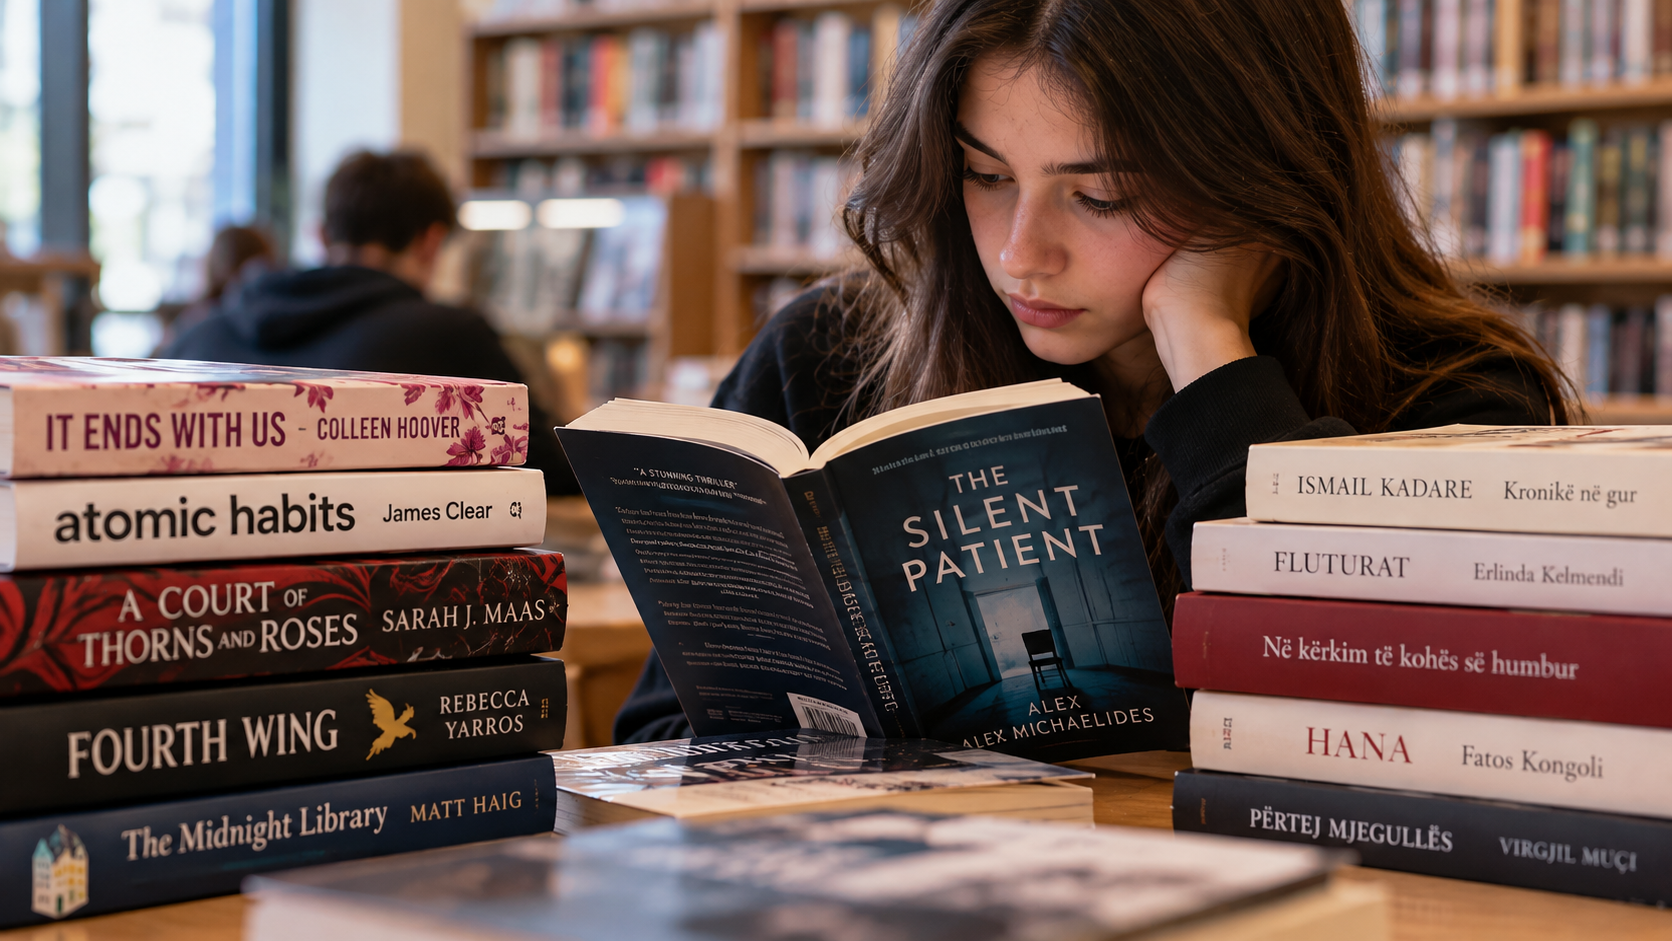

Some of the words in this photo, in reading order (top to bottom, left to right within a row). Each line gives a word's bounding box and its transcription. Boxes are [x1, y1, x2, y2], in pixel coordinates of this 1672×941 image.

[46, 414, 73, 450] IT
[84, 413, 161, 449] ENDS
[171, 412, 243, 448] WITH
[252, 411, 286, 447] US
[317, 417, 391, 441] COLLEEN
[398, 416, 460, 439] HOOVER
[949, 465, 1008, 494] THE
[1297, 475, 1372, 496] ISMAIL
[1380, 477, 1473, 499] KADARE
[1504, 480, 1574, 502] Kronikë
[1580, 484, 1601, 503] në
[1606, 487, 1638, 509] gur
[55, 497, 216, 543] atomic
[231, 493, 355, 535] habits
[383, 503, 440, 523] James
[446, 501, 492, 520] Clear
[902, 485, 1079, 549] SILENT
[901, 524, 1104, 593] PATIENT
[1274, 551, 1410, 579] FLUTURAT
[1473, 562, 1535, 583] Erlinda
[1541, 565, 1624, 588] Kelmendi
[118, 589, 143, 622] A
[158, 581, 275, 619] COURT
[283, 588, 308, 608] OF
[382, 605, 460, 632] SARAH
[463, 605, 477, 628] J.
[484, 599, 545, 625] MAAS
[77, 625, 213, 668] THORNS
[217, 630, 256, 649] AND
[259, 613, 358, 653] ROSES
[1263, 635, 1292, 660] Në
[1297, 638, 1368, 665] kërkim
[1375, 645, 1393, 666] të
[1399, 644, 1458, 672] kohës
[1464, 650, 1486, 673] së
[1492, 651, 1579, 680] humbur
[439, 689, 530, 715] REBECCA
[1028, 695, 1081, 716] ALEX
[67, 718, 227, 779] FOURTH
[242, 709, 339, 759] WING
[445, 714, 524, 739] YARROS
[963, 729, 1007, 749] ALEX
[1012, 707, 1154, 740] MICHAELIDES
[1305, 727, 1413, 764] HANA
[1461, 744, 1513, 770] Fatos
[1521, 750, 1604, 782] Kongoli
[410, 799, 466, 824] MATT
[473, 791, 523, 815] HAIG
[121, 826, 172, 861] The
[177, 809, 292, 854] Midnight
[300, 802, 388, 836] Library
[1249, 806, 1321, 839] PËRTEJ
[1328, 817, 1453, 852] MJEGULLËS
[1499, 836, 1576, 864] VIRGJIL
[1581, 847, 1637, 874] MUÇI
